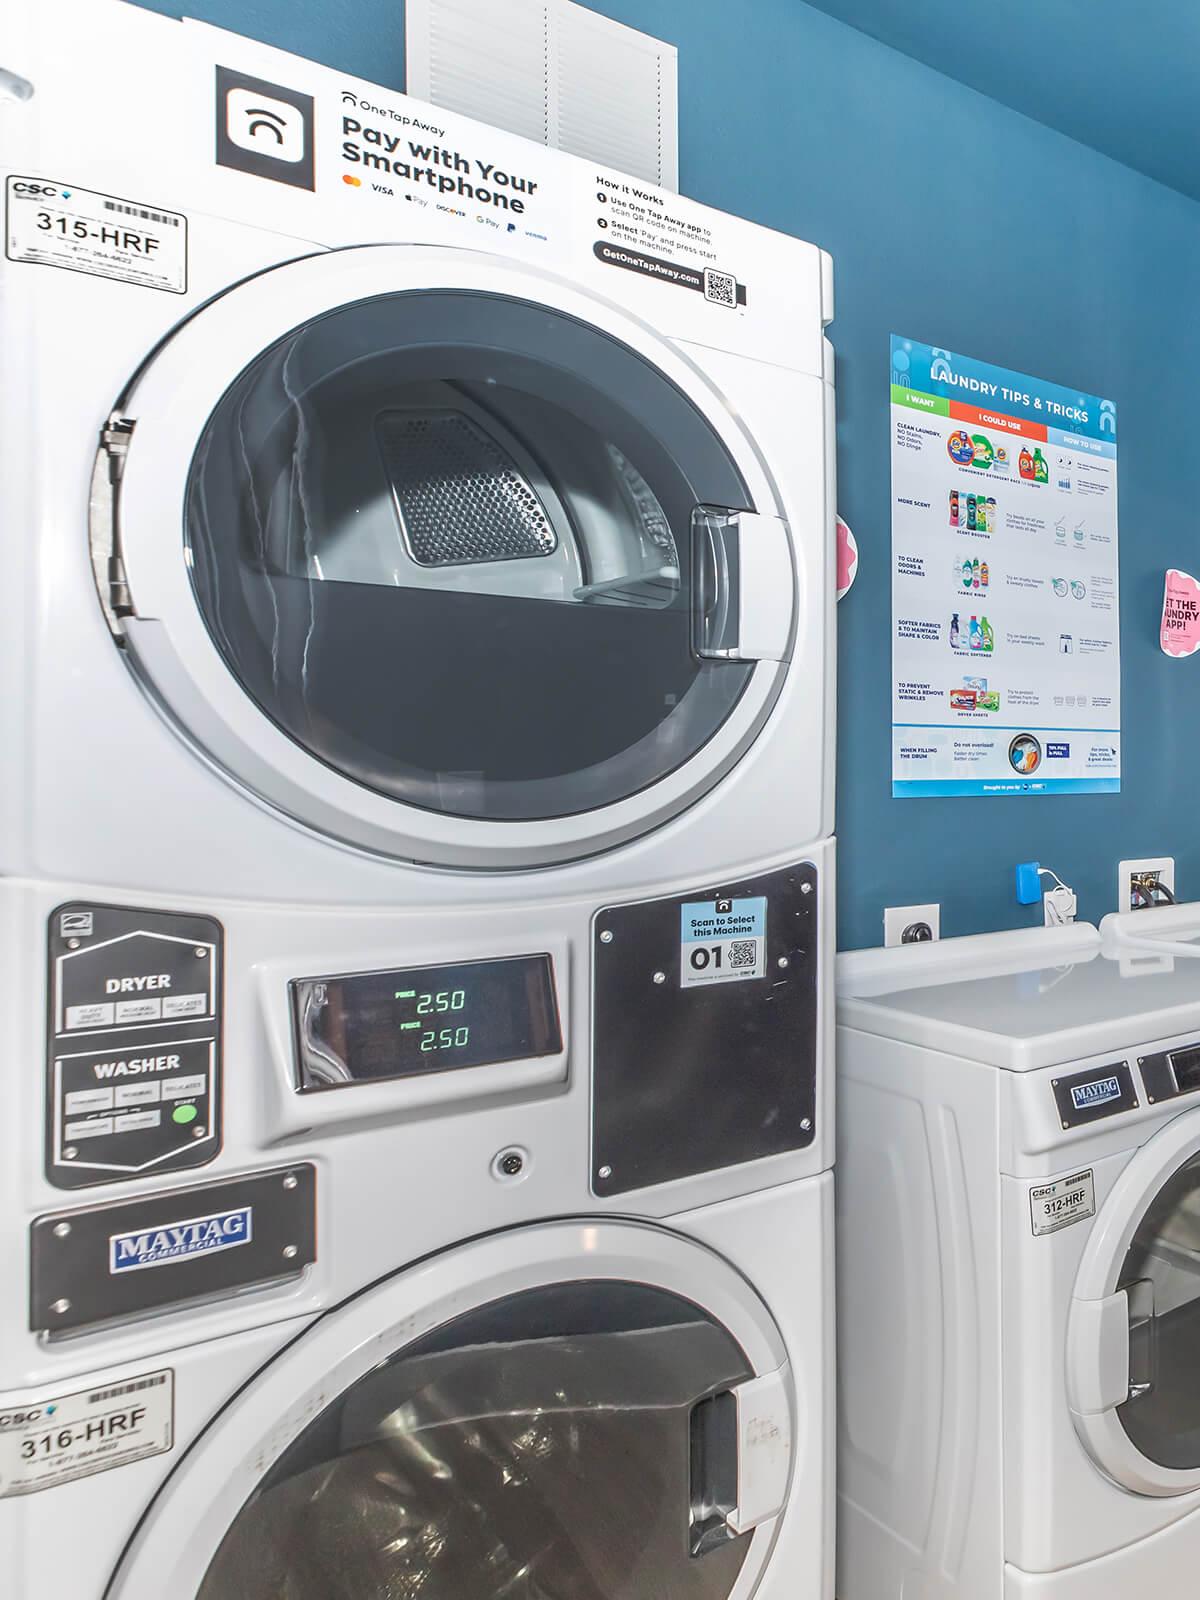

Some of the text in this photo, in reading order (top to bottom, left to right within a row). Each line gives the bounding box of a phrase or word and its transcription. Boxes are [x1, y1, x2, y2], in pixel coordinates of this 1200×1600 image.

[360, 100, 386, 117] One
[411, 118, 445, 137] Away
[342, 116, 538, 196] Pay with Your
[341, 141, 525, 214] Smartphone
[13, 182, 57, 197] CSC
[372, 183, 394, 196] VISA
[596, 176, 664, 206] How it Works
[611, 196, 711, 236] Use One Tap Away app to
[611, 207, 712, 246] scan QR code on machine.
[36, 212, 160, 254] 315-HRF
[611, 221, 638, 235] Select
[660, 237, 674, 246] and
[677, 242, 697, 255] press
[699, 248, 716, 260] start
[624, 233, 637, 243] the
[640, 237, 674, 255] machine.
[603, 248, 699, 285] GetOneTapAway.com
[911, 396, 935, 407] WANT
[930, 368, 1089, 423] LAUNDRY TIPS & TRICKS
[897, 423, 942, 438] CLEAN LAUNDRY,
[983, 415, 1007, 427] COULD
[1008, 421, 1022, 430] USE
[1063, 436, 1079, 446] HOW
[1090, 443, 1102, 451] USE
[898, 569, 925, 577] MACHINES
[1176, 600, 1197, 610] THE
[1166, 619, 1186, 630] APP!
[691, 919, 714, 927] Scan
[727, 916, 755, 924] Select
[713, 926, 752, 936] Machine
[690, 946, 722, 970] 01
[106, 974, 172, 994] DRYER
[417, 991, 465, 1014] 2.50
[421, 1027, 469, 1051] 2.50
[94, 1054, 180, 1079] WASHER
[1074, 1079, 1117, 1101] MAYTAG
[1032, 1188, 1051, 1197] CSC
[1044, 1190, 1085, 1214] 312-HRF
[118, 1214, 244, 1260] MAYTAG
[138, 1237, 223, 1263] COMMERCIAL
[0, 1410, 42, 1426] CSC
[21, 1407, 147, 1459] 316-HRF
